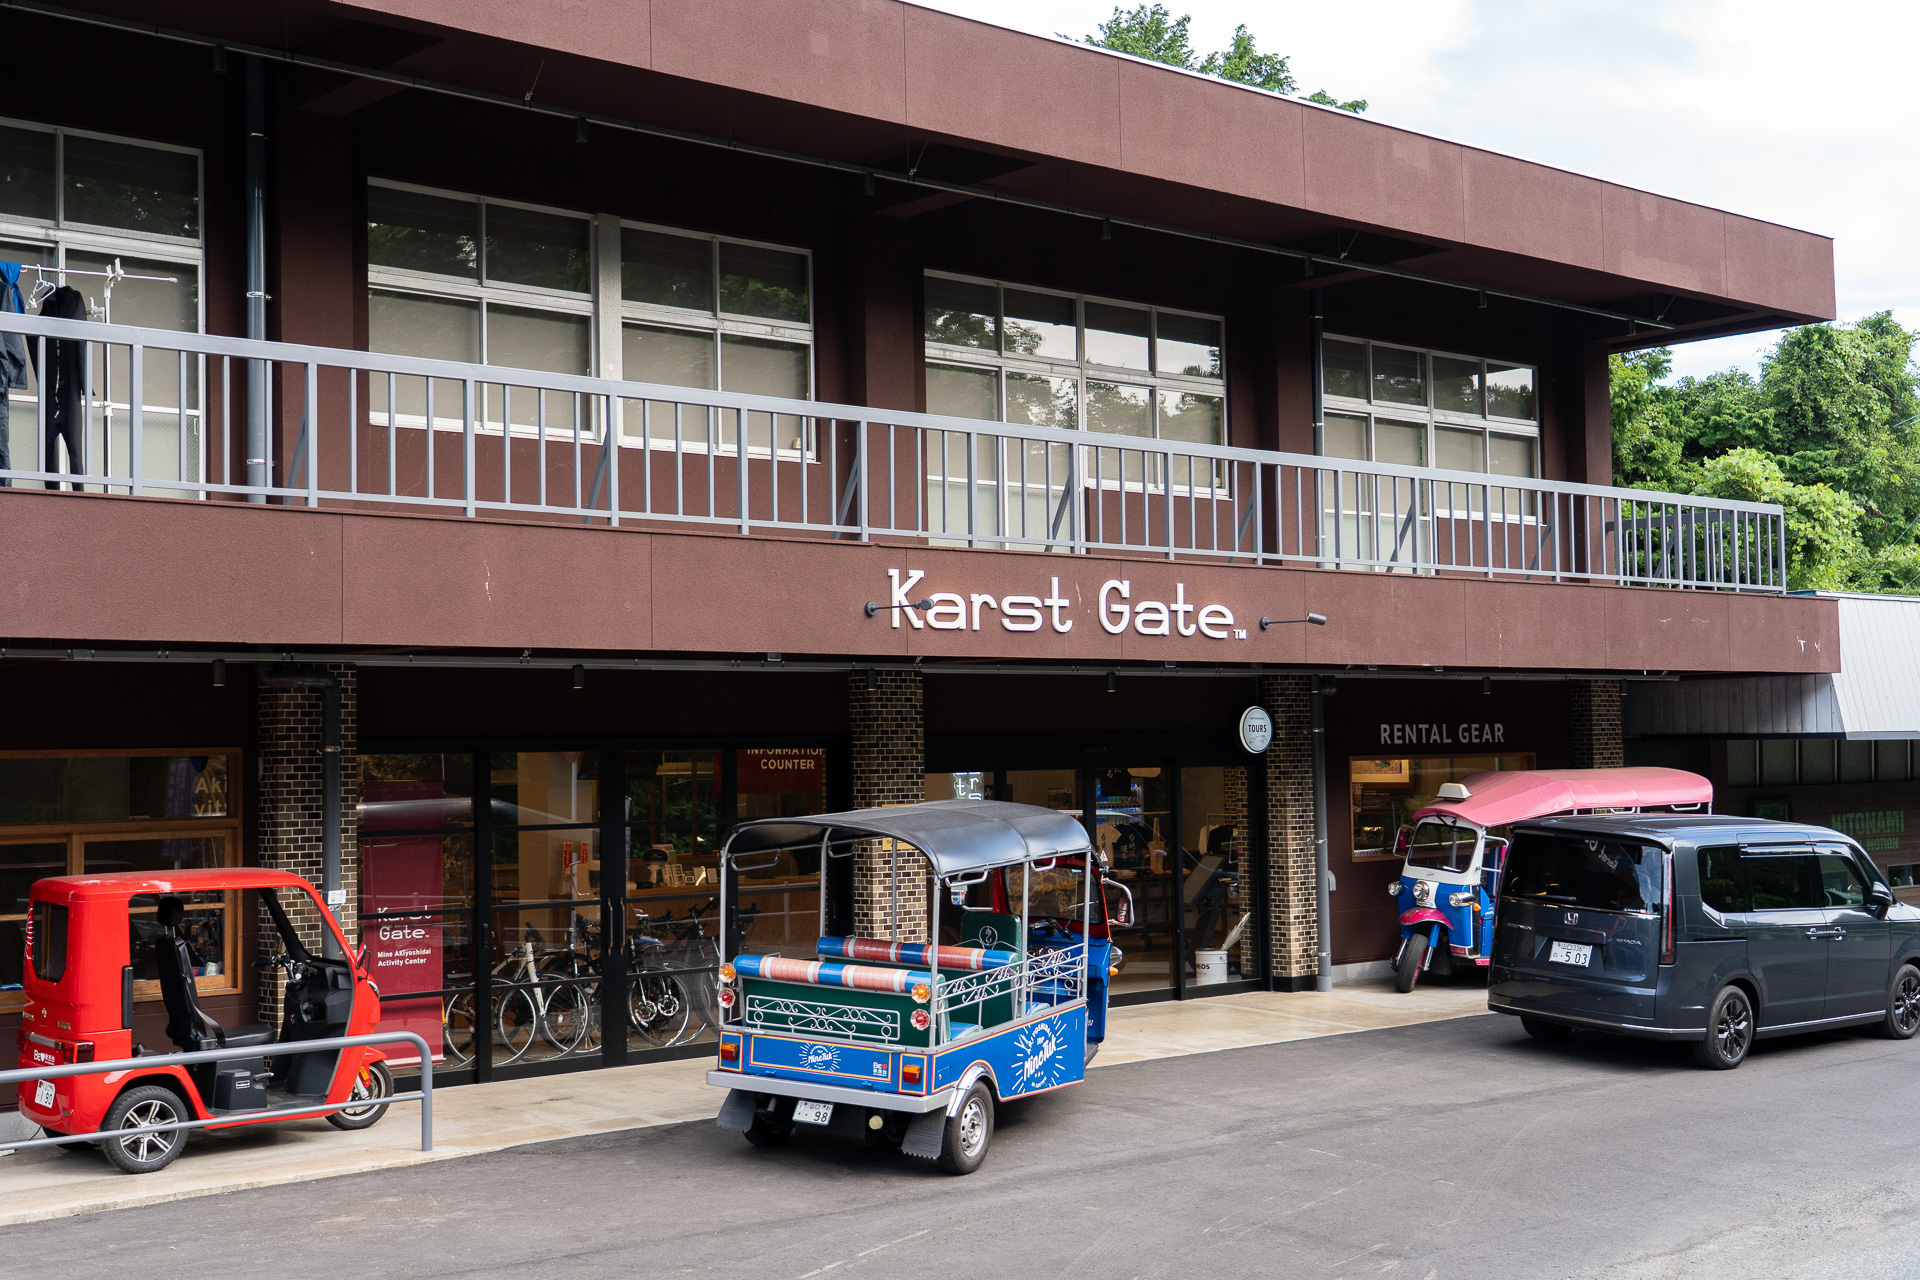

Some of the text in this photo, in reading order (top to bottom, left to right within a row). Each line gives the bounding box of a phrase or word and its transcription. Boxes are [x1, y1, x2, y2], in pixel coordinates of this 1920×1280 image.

[887, 568, 1073, 633] Karst
[1098, 579, 1235, 640] Gate
[1248, 724, 1267, 733] TOURS
[1380, 723, 1504, 744] RENTAL GEAR
[760, 759, 815, 769] COUNTER
[1831, 810, 1905, 835] HITONAMI
[1866, 837, 1899, 850] MOTION
[379, 924, 425, 940] Gate
[394, 947, 432, 957] Akiyoshidai
[377, 959, 403, 967] Activity
[814, 1111, 828, 1122] 98
